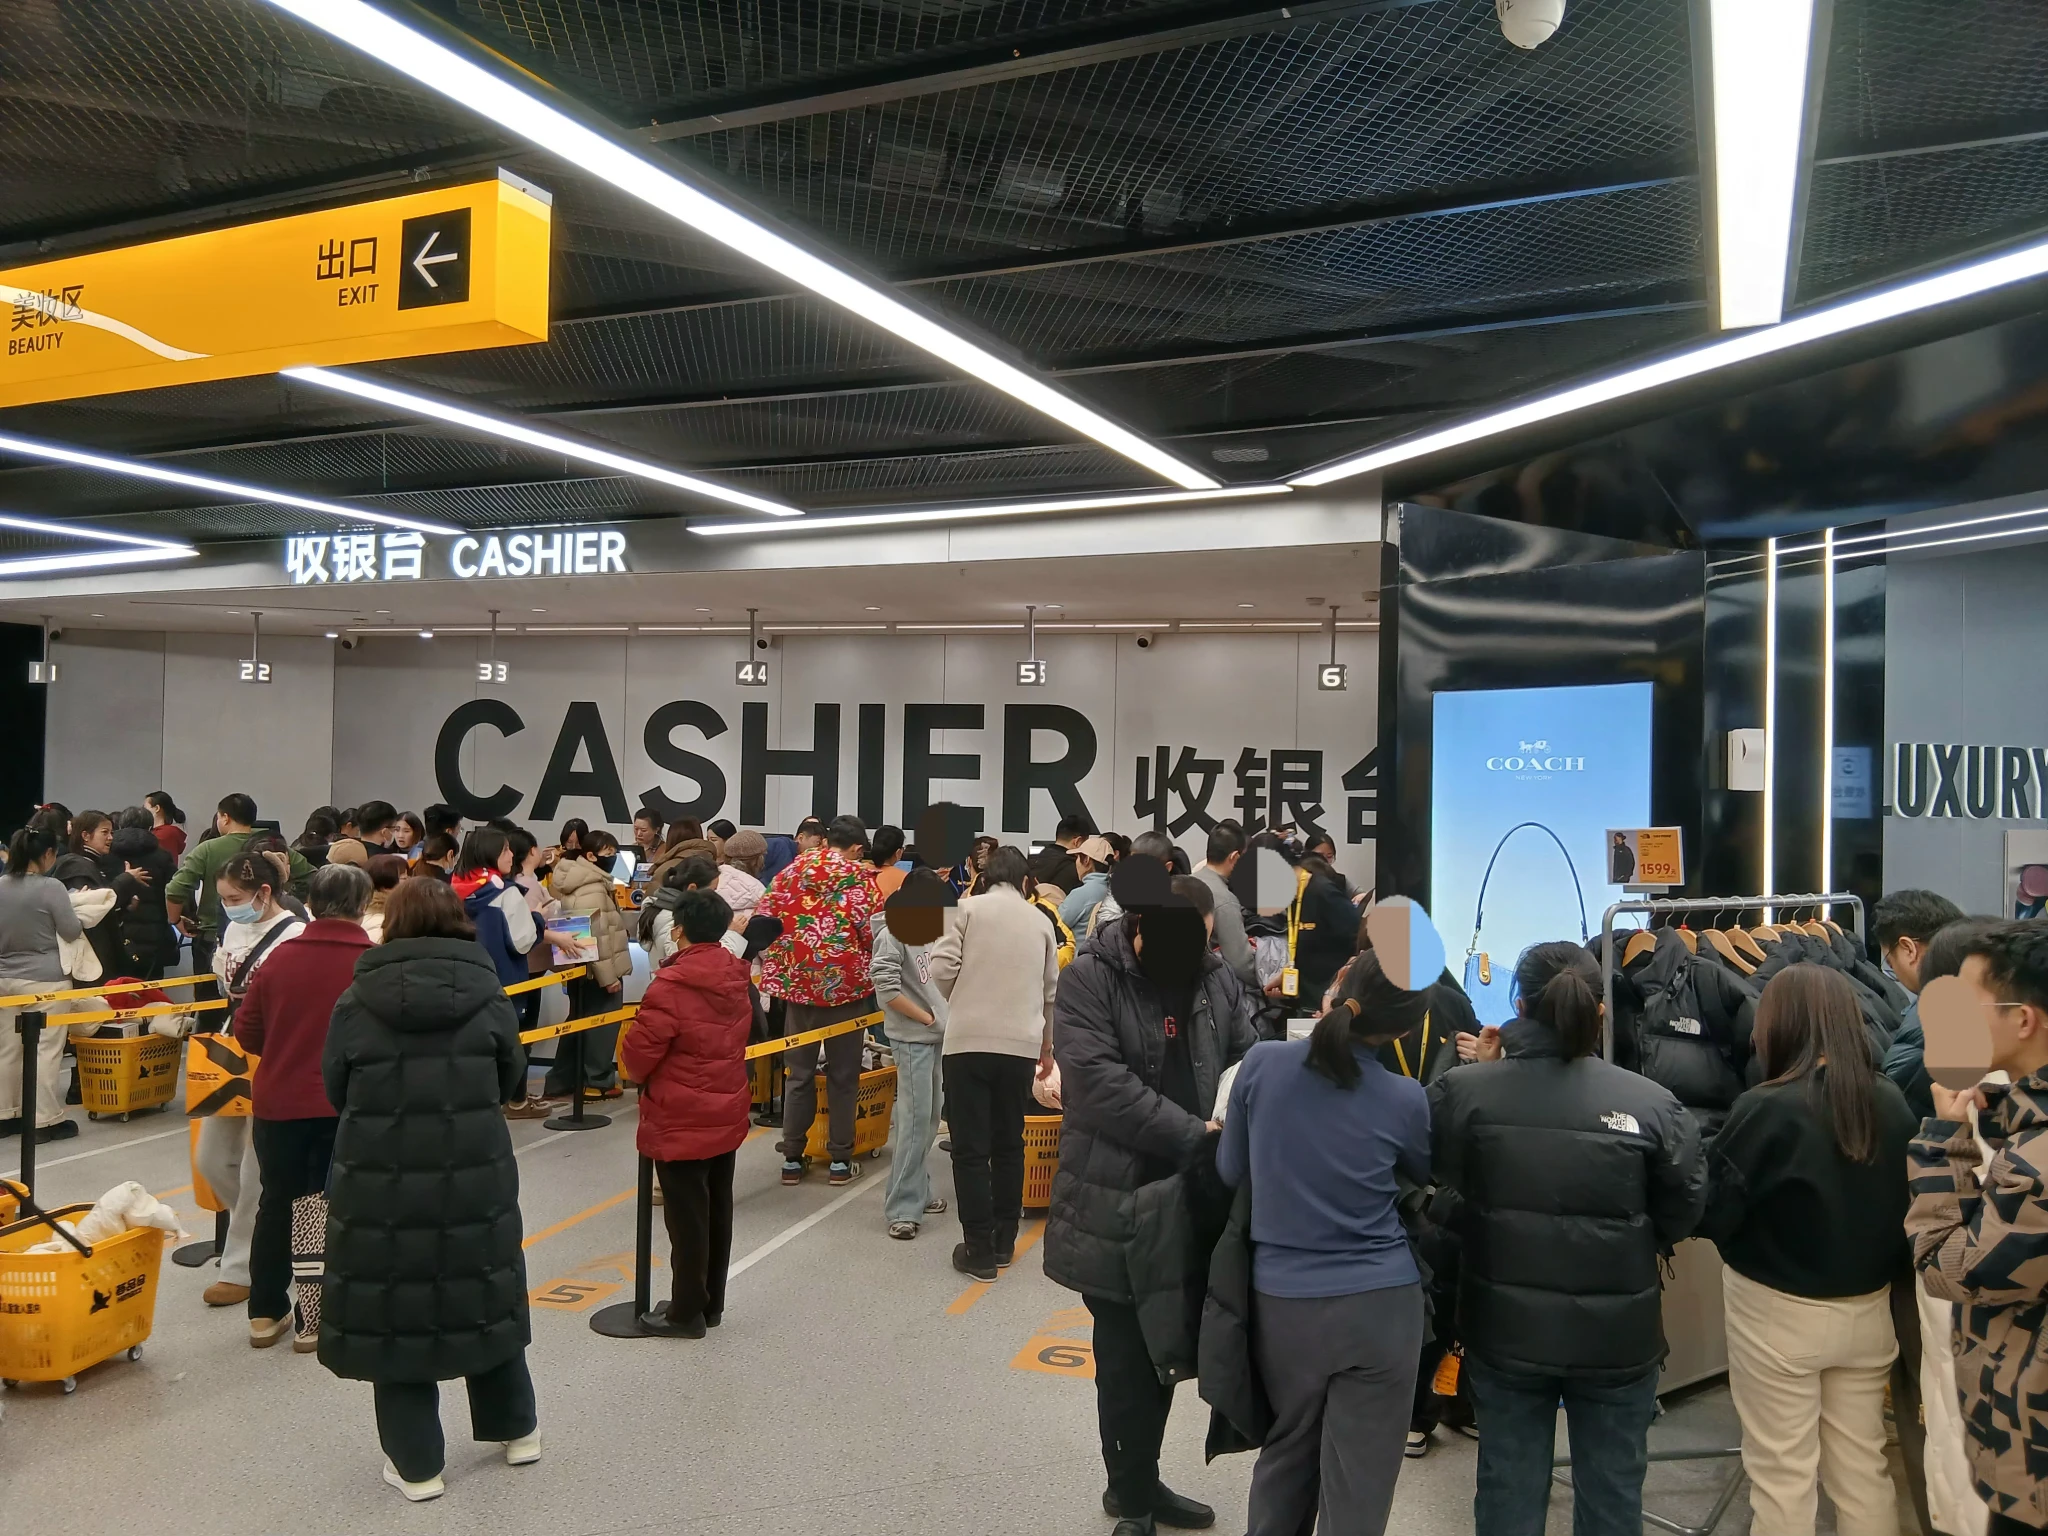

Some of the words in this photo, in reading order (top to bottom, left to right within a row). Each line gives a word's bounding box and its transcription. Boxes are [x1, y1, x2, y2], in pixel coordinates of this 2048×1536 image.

[316, 236, 377, 280] 出口
[338, 283, 379, 306] EXIT
[11, 285, 84, 332] 美妆区
[8, 331, 63, 355] BEAUTY
[287, 531, 427, 584] 收银台
[452, 531, 626, 578] CASHIER
[1020, 664, 1036, 683] 5
[1322, 667, 1340, 687] 6
[434, 698, 1101, 836] CASHIER
[1485, 756, 1586, 772] COACH
[1599, 1114, 1627, 1125] NORTH
[1610, 1110, 1627, 1120] THE
[1607, 1122, 1627, 1132] FACE
[535, 1284, 599, 1304] 5
[1037, 1345, 1092, 1368] 6
